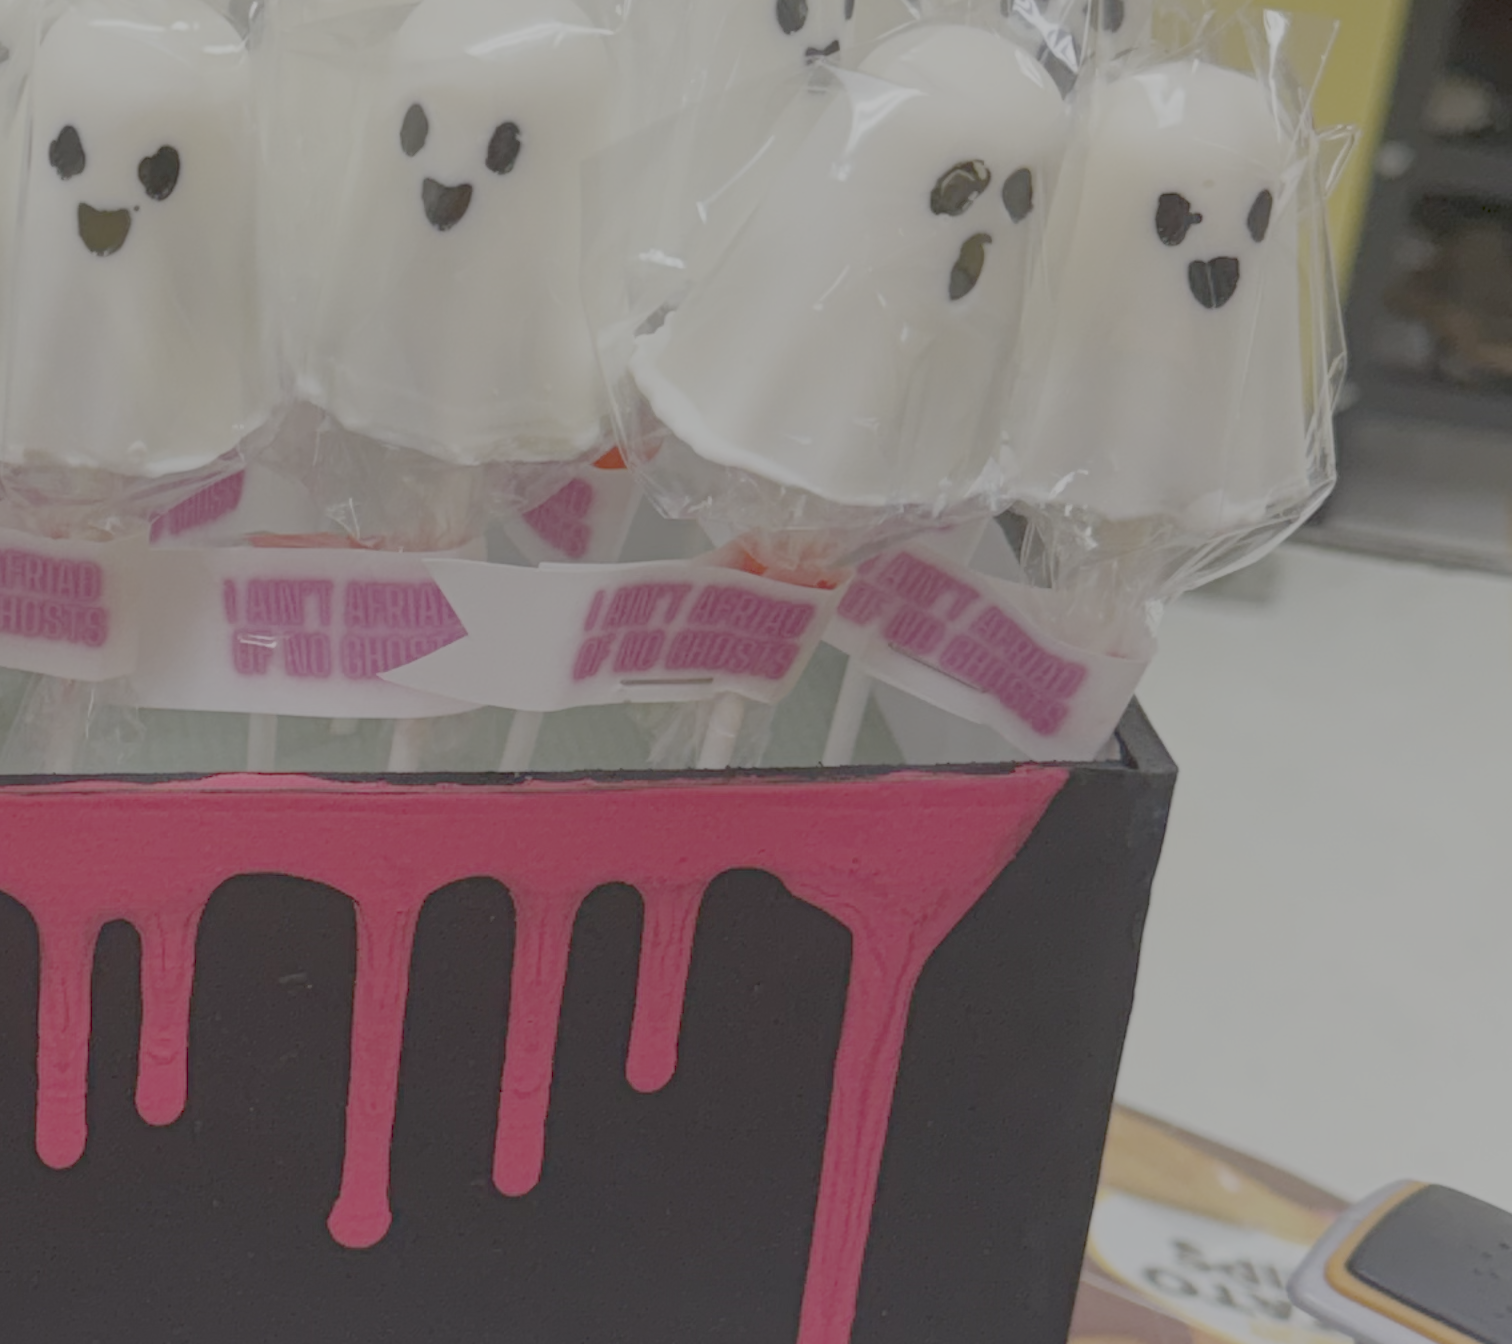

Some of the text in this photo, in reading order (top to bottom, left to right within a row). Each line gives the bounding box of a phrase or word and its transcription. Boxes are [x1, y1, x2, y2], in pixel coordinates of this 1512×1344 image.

[223, 579, 237, 625] I
[245, 578, 334, 627] AIN'T
[601, 583, 692, 629] AIN'T
[285, 632, 332, 677] NO
[573, 629, 800, 680] OF NO GHOSTS
[885, 610, 945, 655] NO
